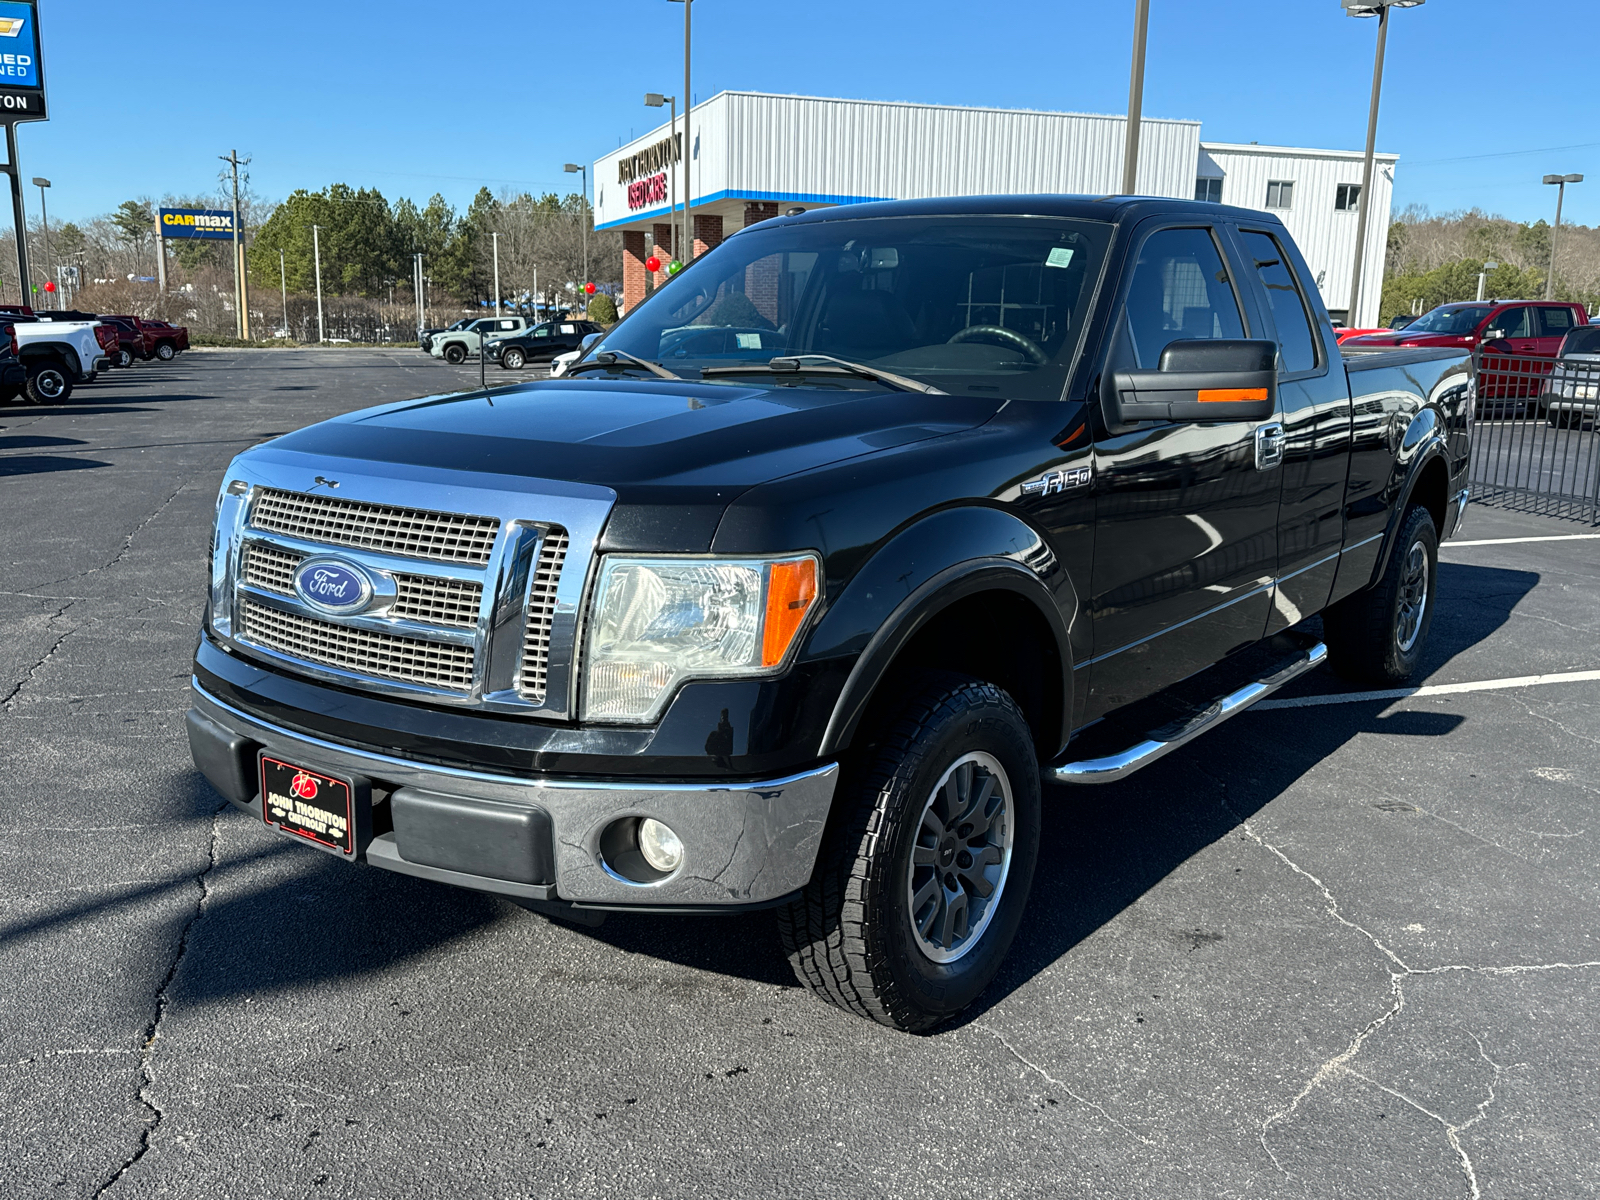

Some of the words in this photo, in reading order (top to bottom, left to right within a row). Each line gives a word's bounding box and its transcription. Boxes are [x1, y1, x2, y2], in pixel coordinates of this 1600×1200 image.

[618, 154, 636, 184] JOHN
[636, 132, 682, 178] THORNTON
[628, 181, 646, 209] USED
[645, 172, 667, 204] CARS
[309, 569, 348, 598] Ford
[268, 792, 293, 811] JOHN
[295, 800, 347, 831] THORNTON
[288, 813, 327, 834] CHEVROLET
